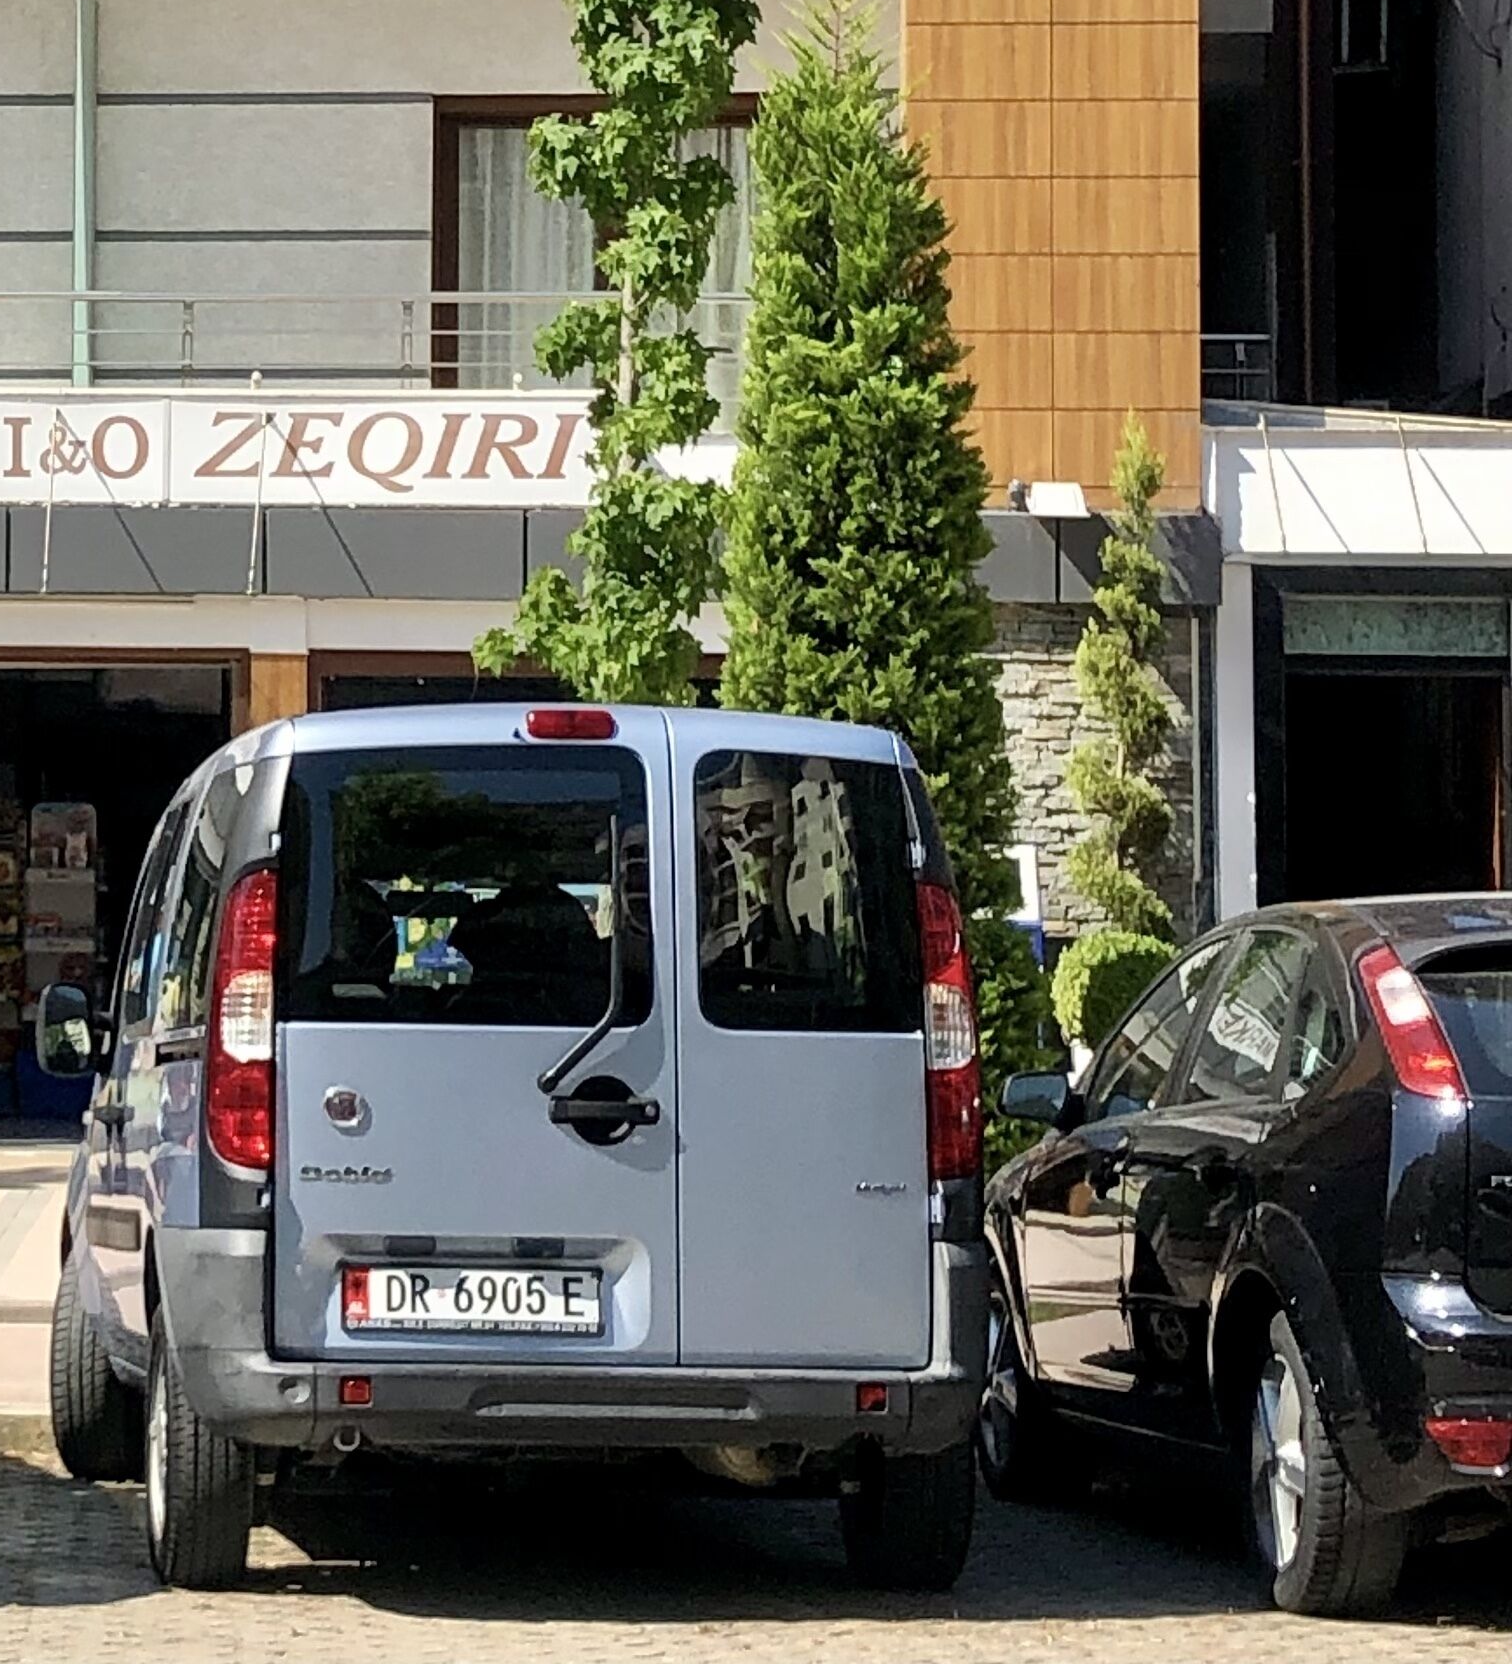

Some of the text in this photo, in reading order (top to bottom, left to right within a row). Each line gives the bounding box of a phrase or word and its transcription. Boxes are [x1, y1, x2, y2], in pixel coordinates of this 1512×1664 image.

[194, 412, 585, 493] ZEQIRI
[386, 1273, 585, 1317] DR 6905 E
